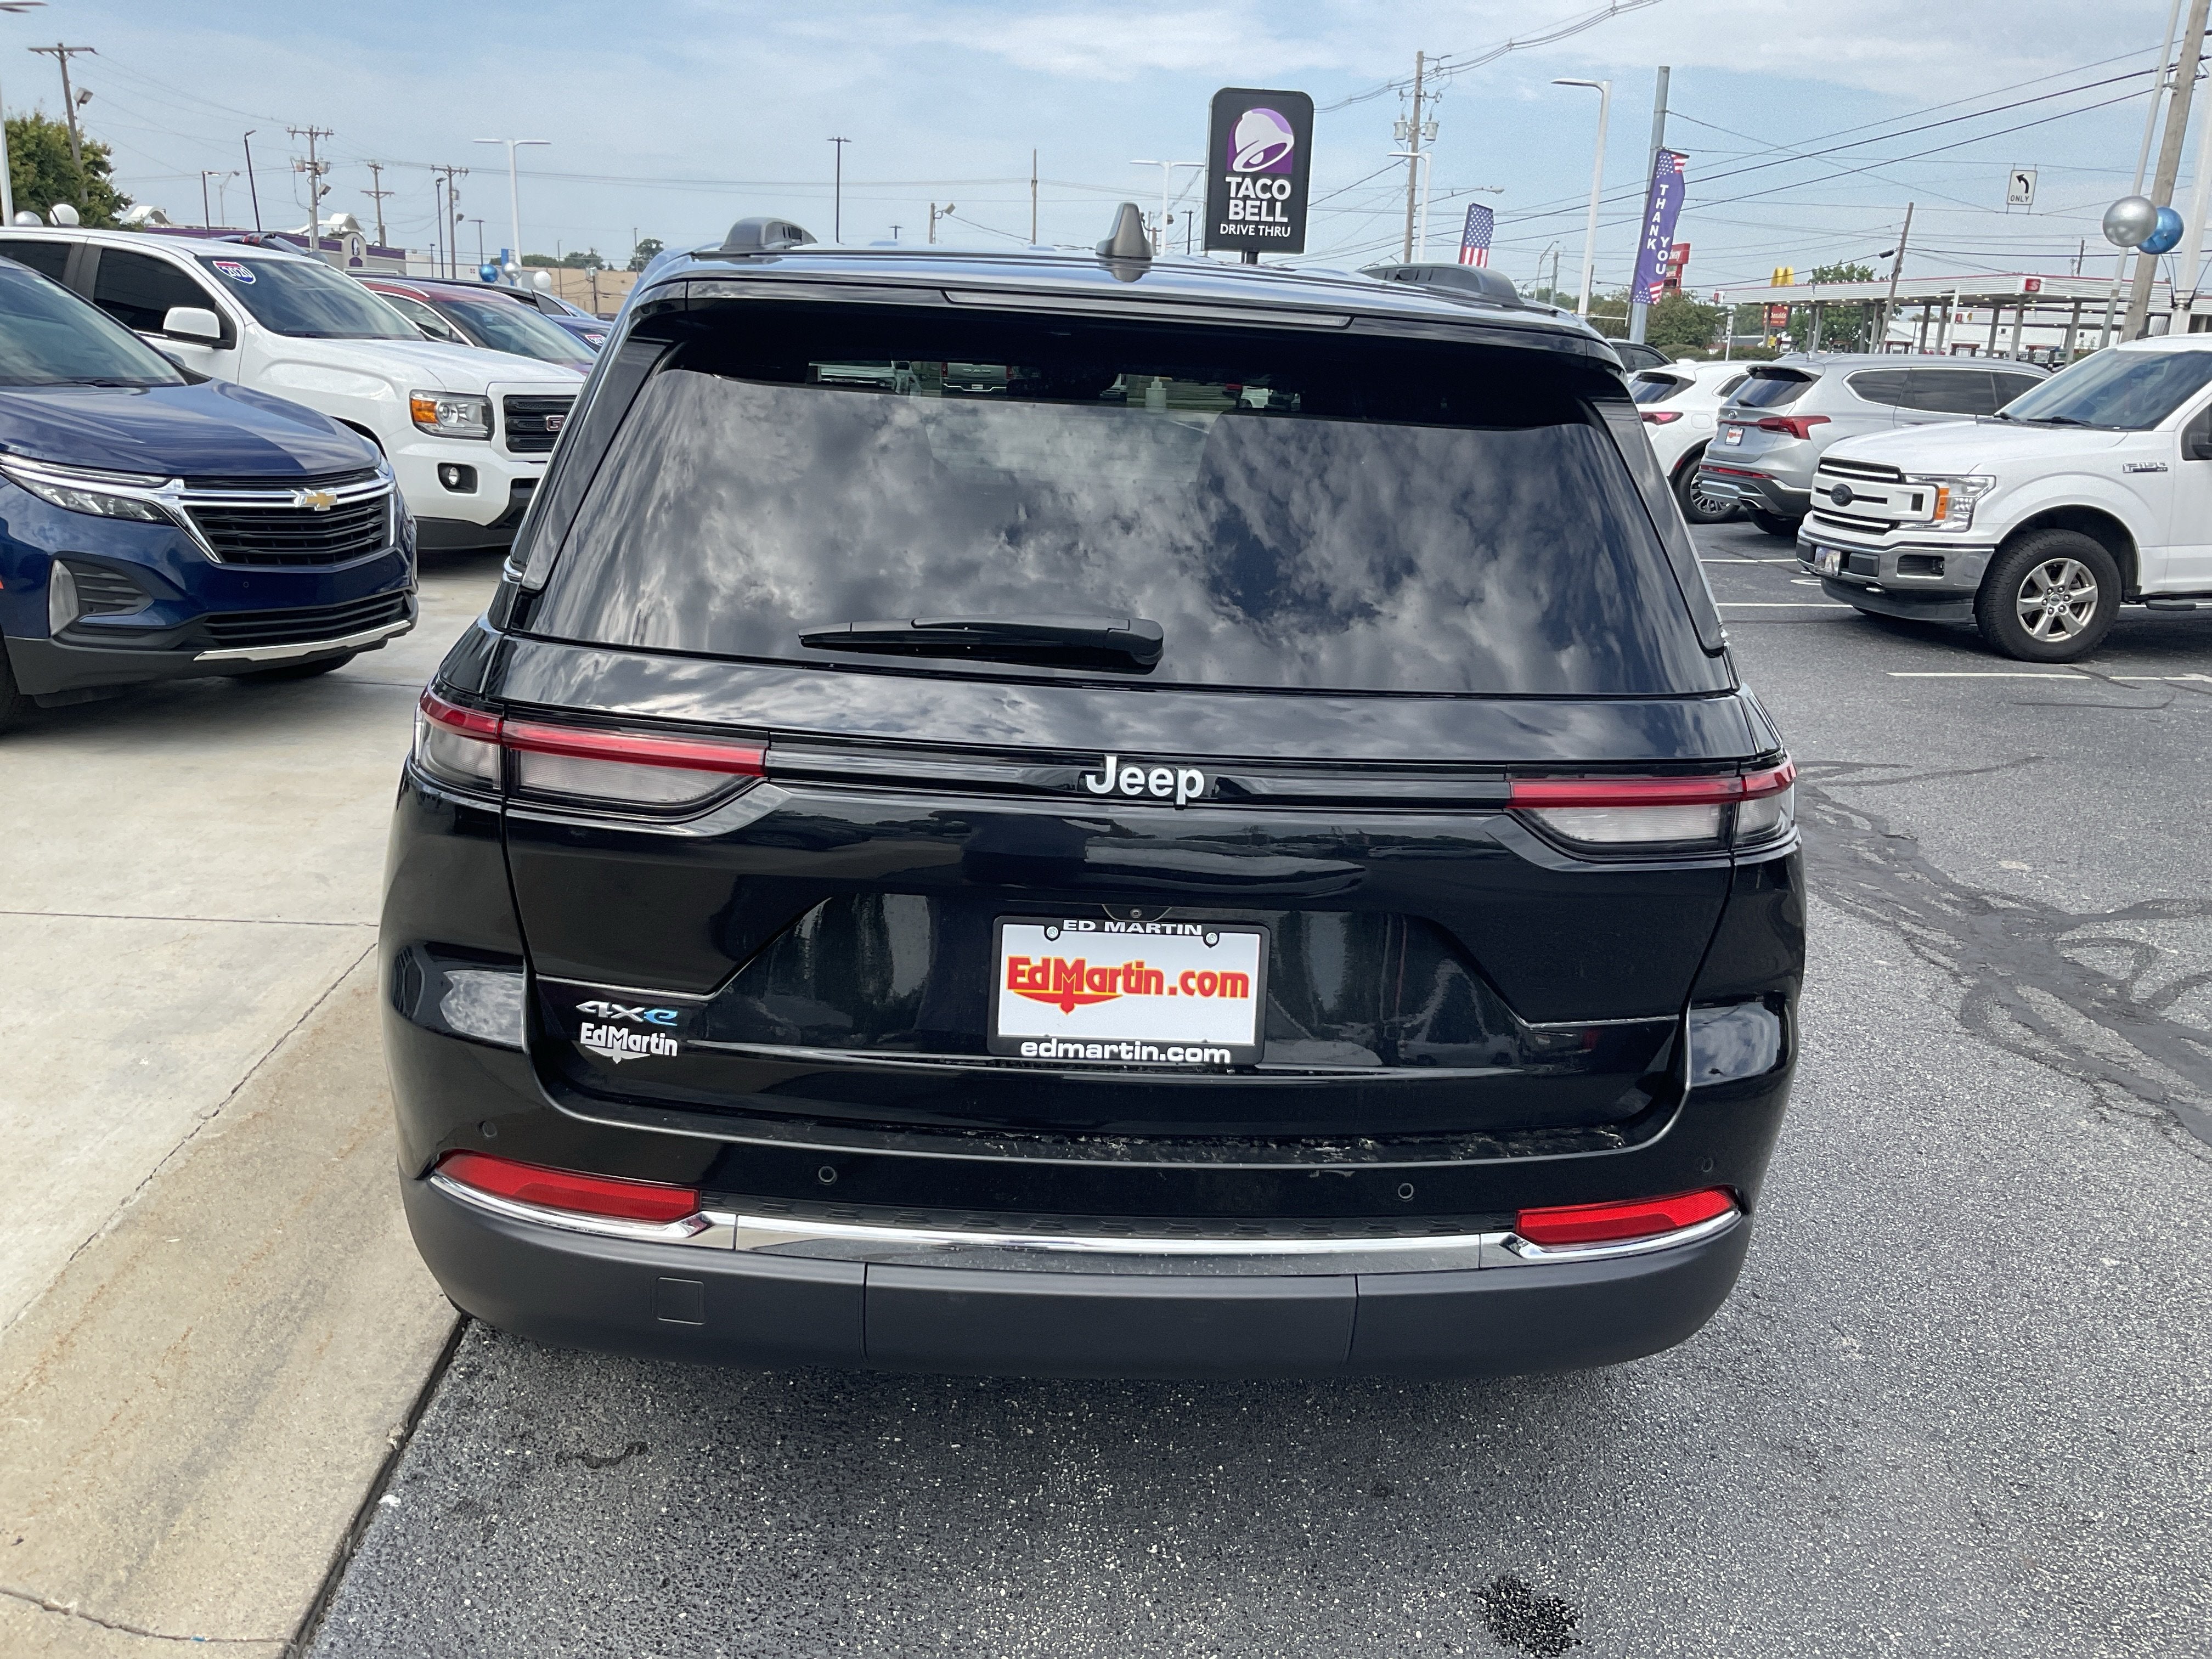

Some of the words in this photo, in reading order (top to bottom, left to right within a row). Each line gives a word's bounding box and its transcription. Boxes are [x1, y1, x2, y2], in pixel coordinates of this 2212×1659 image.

[1225, 177, 1291, 200] TACO
[1228, 199, 1288, 223] BELL
[1646, 184, 1669, 250] THANK
[1220, 223, 1255, 235] DRIVE
[1258, 225, 1290, 237] THRU
[1655, 236, 1670, 274] YOU
[221, 267, 253, 278] 2020
[1085, 755, 1204, 806] Jeep
[1063, 919, 1096, 931] ED
[1104, 921, 1202, 935] MARTIN
[1007, 955, 1249, 999] EdMartin.com
[580, 1022, 678, 1057] EdMartin
[1020, 1038, 1231, 1063] edmartin.com
